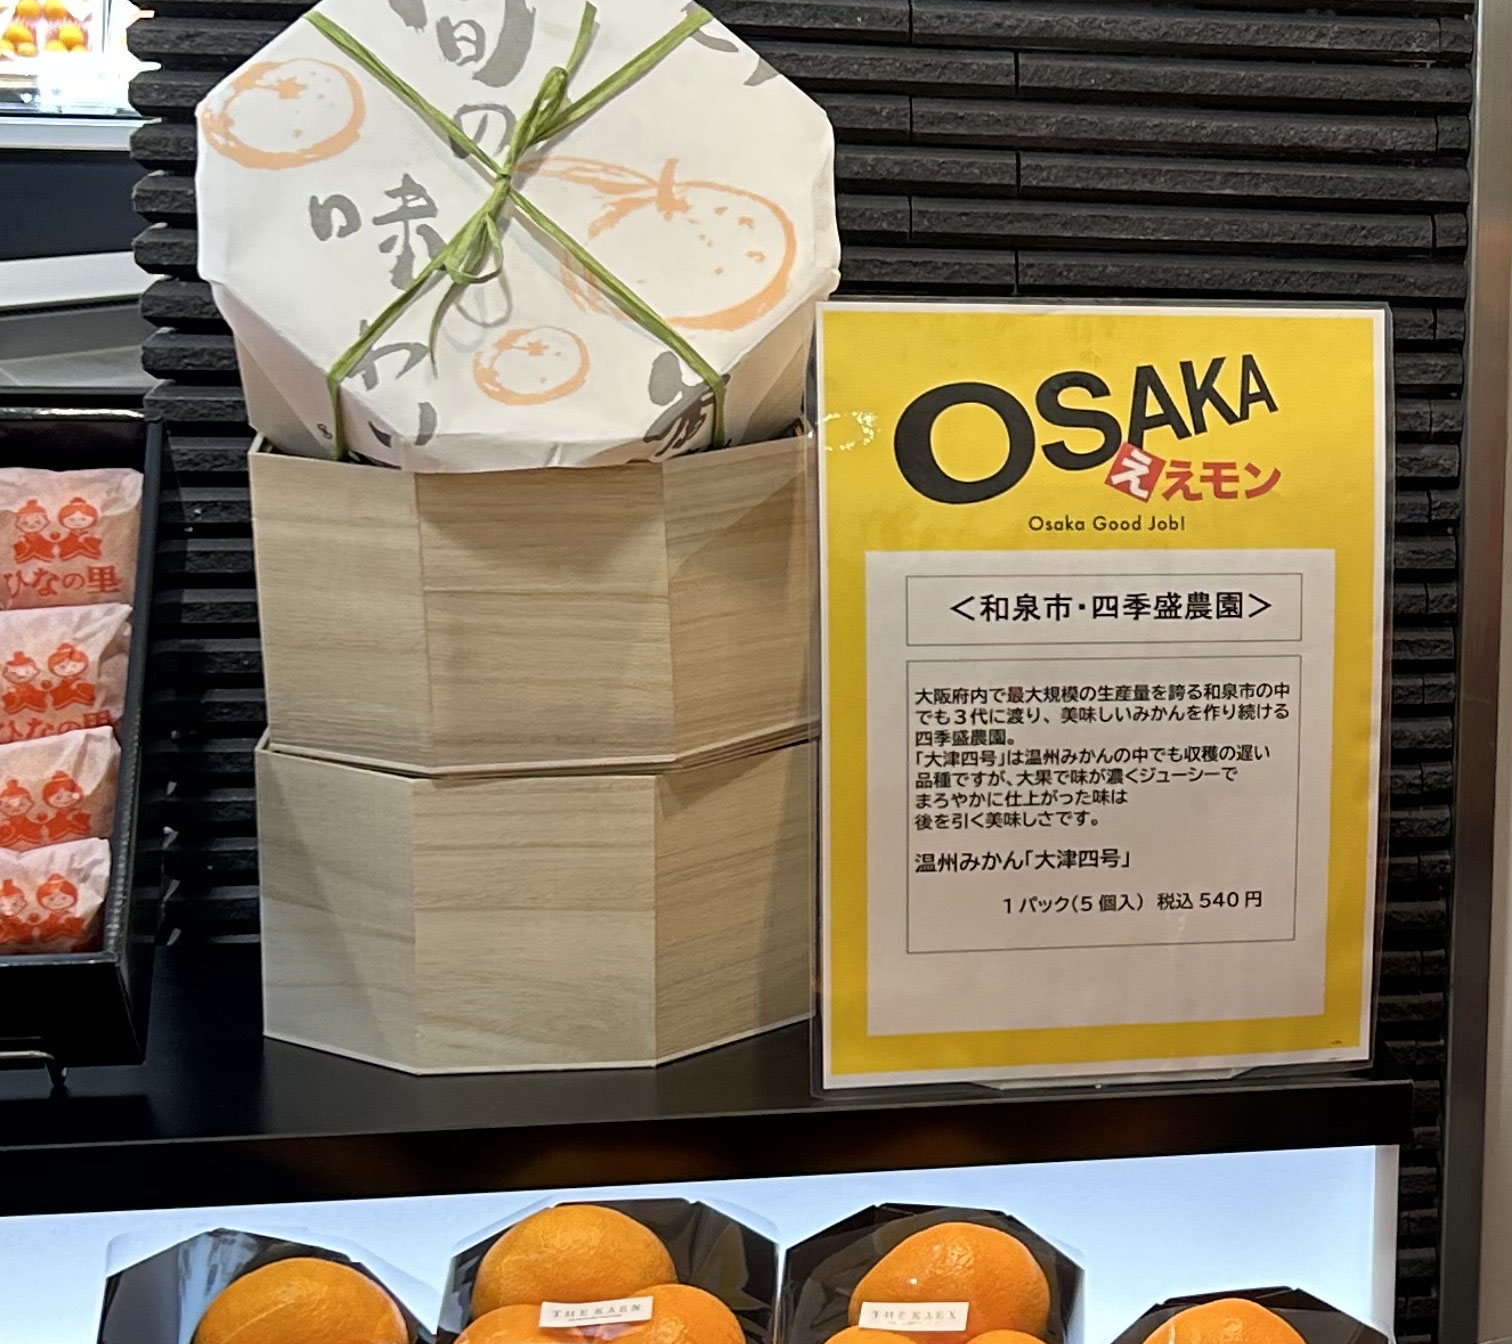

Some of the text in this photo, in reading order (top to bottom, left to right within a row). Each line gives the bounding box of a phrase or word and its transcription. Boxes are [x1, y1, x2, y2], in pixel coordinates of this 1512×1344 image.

[894, 353, 1279, 505] OSAKA
[1108, 446, 1282, 502] ええモン
[1028, 514, 1186, 531] Osaka Good Job!
[3, 564, 121, 598] ひなの里
[915, 682, 1290, 705] 大阪府内で最大規模の生産量を誇る和泉市の中
[915, 728, 1015, 747] 四季盛農園。
[915, 744, 1271, 767] 「大津四号」は温州みかんの中でも収穫の遅い
[915, 766, 1239, 789] 品種ですが、大果で味が濃くジューシーで
[915, 788, 1129, 809] まろやかに仕上がった味は
[914, 809, 1099, 831] 後を引く美味しさです。
[915, 848, 1131, 873] 温州みかん「大津四号」
